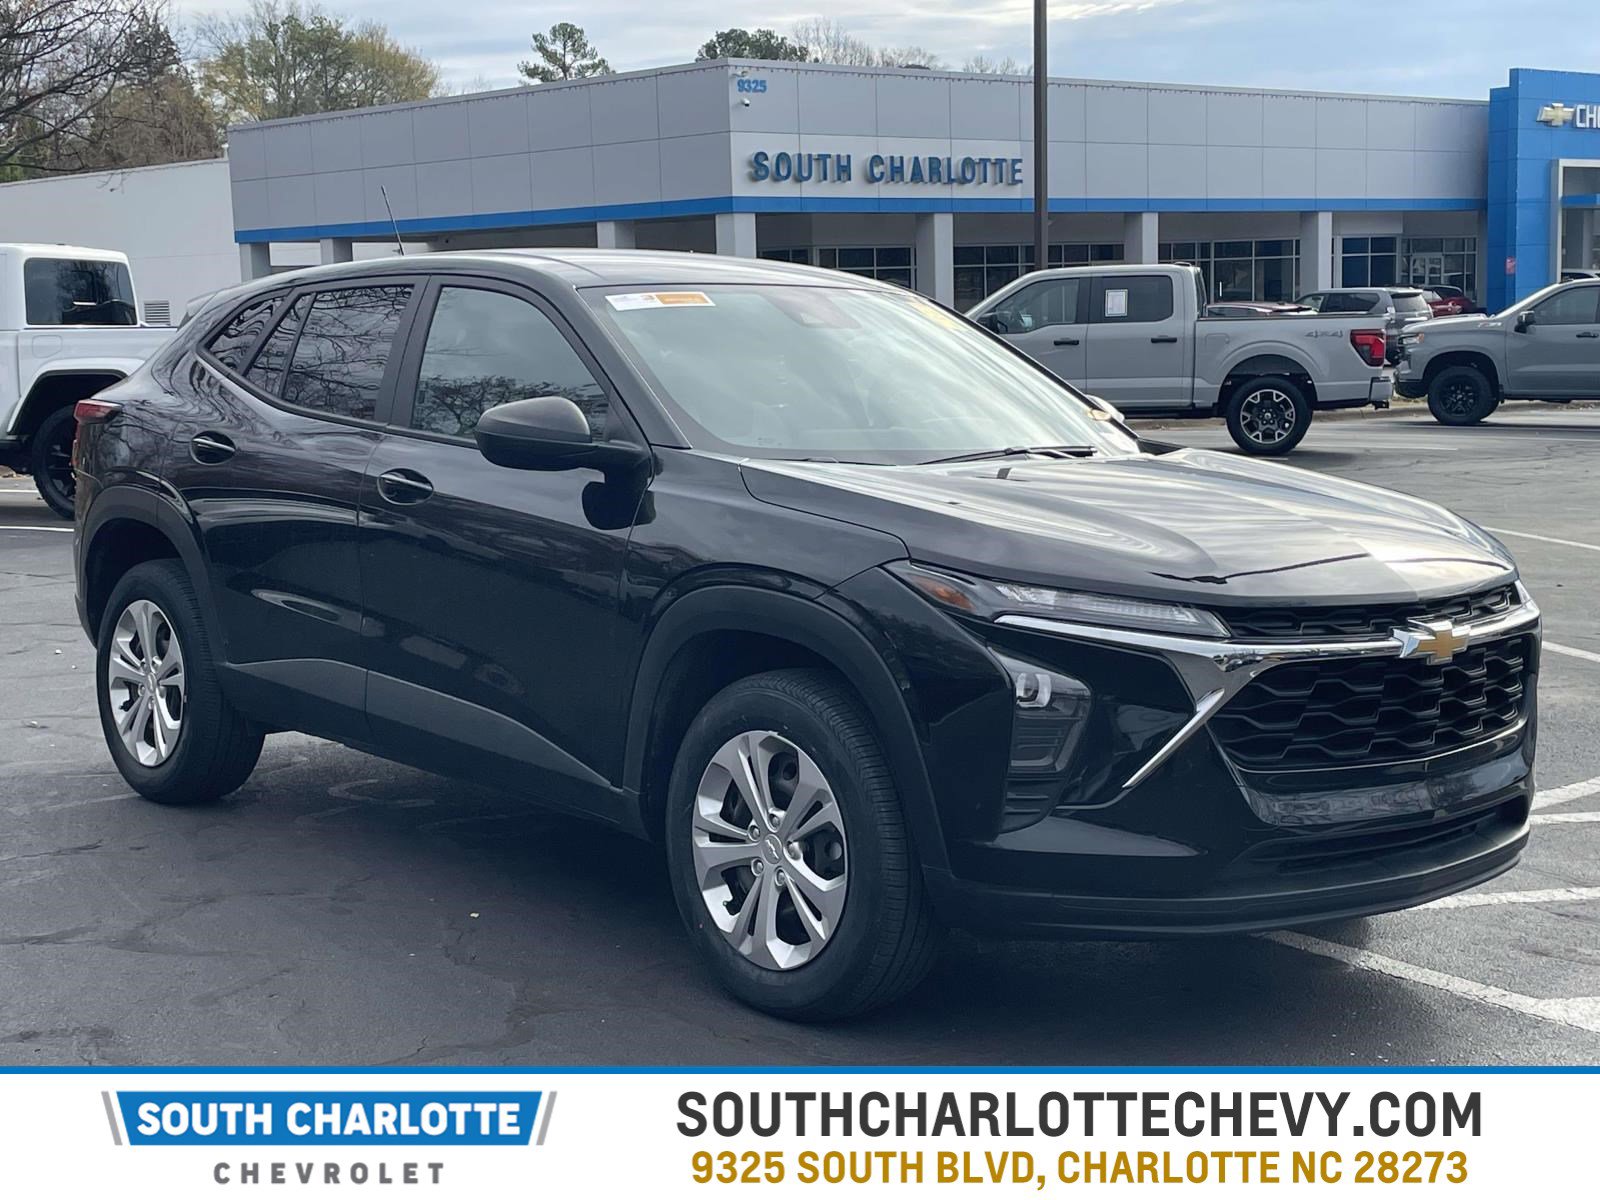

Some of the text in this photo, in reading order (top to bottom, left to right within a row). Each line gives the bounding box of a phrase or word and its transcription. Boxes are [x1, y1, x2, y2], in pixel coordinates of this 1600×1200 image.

[737, 79, 767, 93] 9325
[1576, 104, 1600, 129] CH
[752, 151, 1023, 185] SOUTH CHARLOTTE
